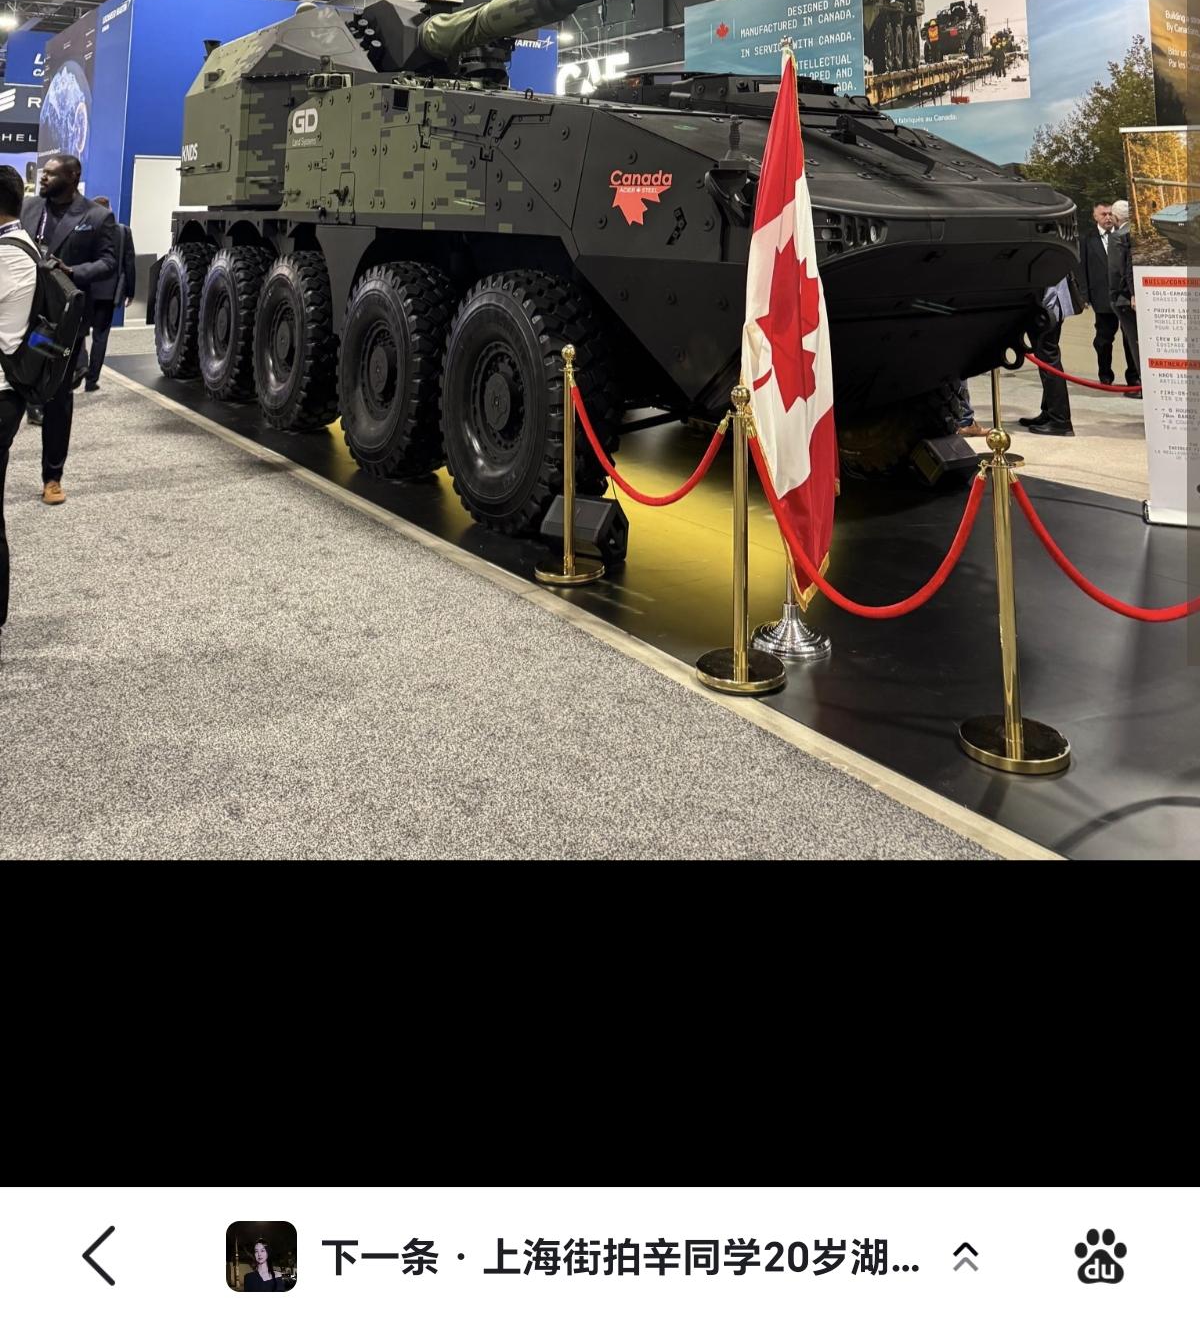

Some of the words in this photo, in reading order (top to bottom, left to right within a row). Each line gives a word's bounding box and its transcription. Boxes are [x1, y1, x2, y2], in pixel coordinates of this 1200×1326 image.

[787, 0, 829, 17] DESIGNED
[740, 18, 798, 39] MANUFACTURED
[802, 16, 813, 27] IN
[818, 9, 856, 24] CANADA.
[740, 48, 750, 59] IN
[754, 42, 782, 56] SERVIC
[792, 37, 814, 50] WITH
[818, 31, 856, 46] CANADA.
[836, 67, 853, 78] AND
[292, 108, 319, 134] GD
[182, 143, 198, 162] KNDS
[610, 169, 673, 186] Canada
